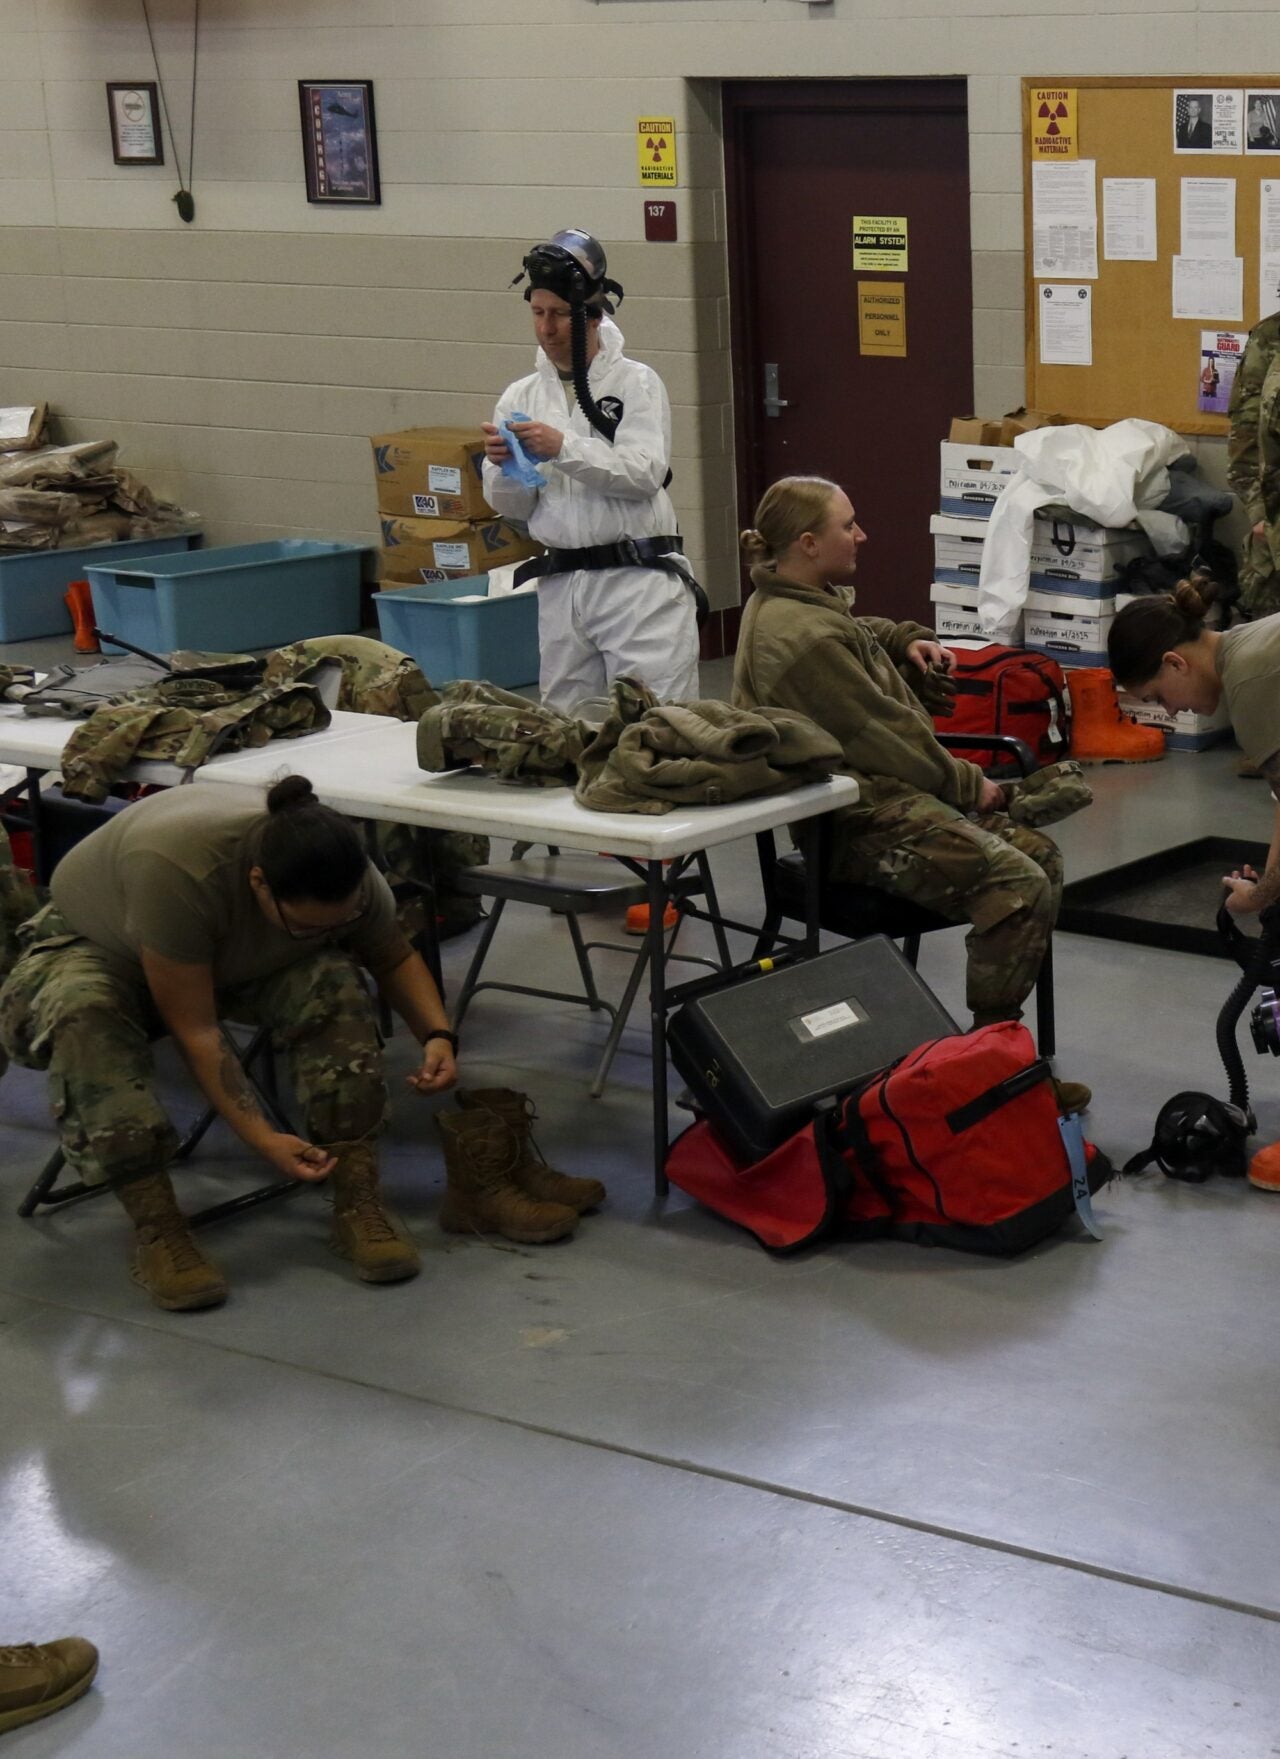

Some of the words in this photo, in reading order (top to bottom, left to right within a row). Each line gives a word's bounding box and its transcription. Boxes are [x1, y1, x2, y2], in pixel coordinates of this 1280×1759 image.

[1037, 91, 1069, 100] CAUTION
[640, 123, 672, 133] CAUTION
[1034, 136, 1072, 145] RADIOACTIVE
[314, 105, 325, 193] COURAGE
[1038, 145, 1069, 154] MATERIALS
[642, 172, 674, 180] MATERIALS
[648, 205, 665, 216] 137
[855, 235, 877, 244] ALARM
[879, 236, 905, 245] SYSTEM
[864, 313, 900, 321] PERSONNEL
[874, 329, 891, 337] ONLY
[1217, 342, 1240, 352] GUARD
[1074, 1176, 1088, 1200] 24
